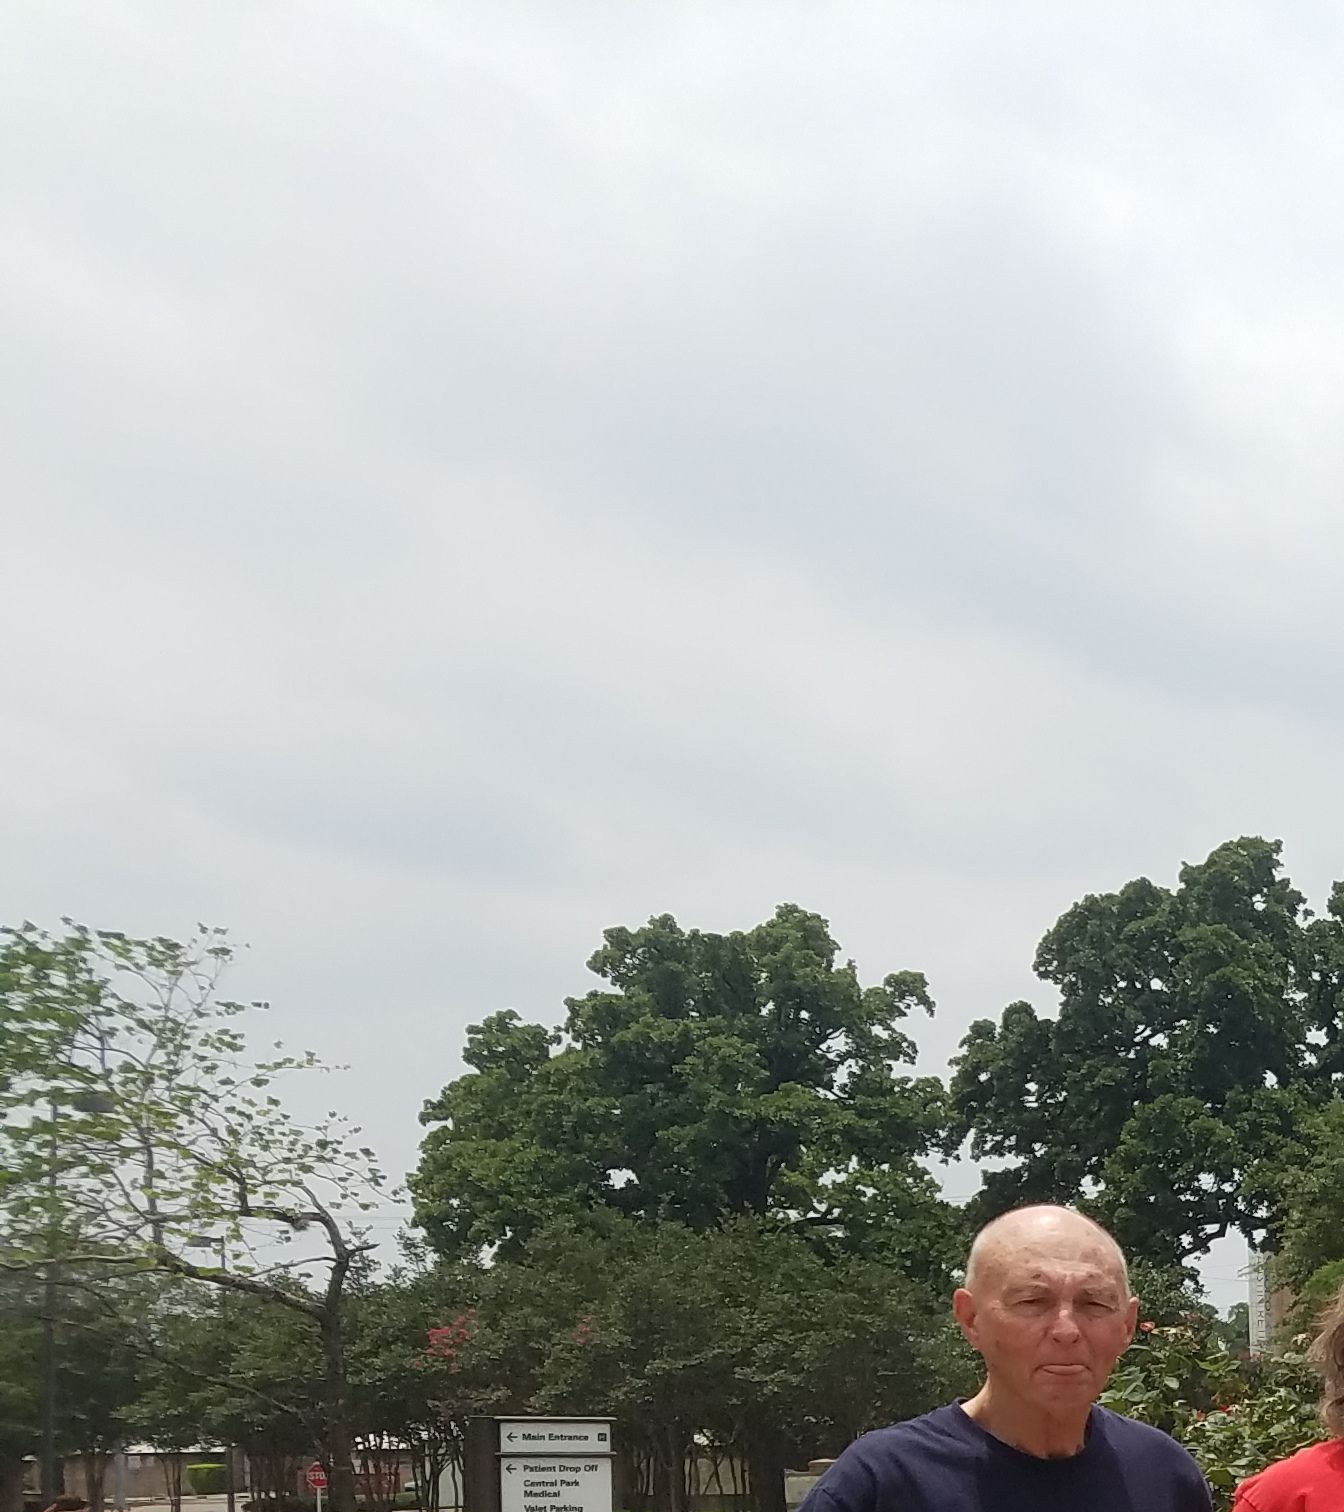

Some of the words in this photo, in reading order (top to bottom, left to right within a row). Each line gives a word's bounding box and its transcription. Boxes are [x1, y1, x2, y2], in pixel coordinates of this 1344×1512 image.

[522, 1433, 545, 1441] Main
[548, 1433, 589, 1441] Entrance
[523, 1464, 556, 1472] Patient
[559, 1465, 581, 1474] Drop
[584, 1464, 598, 1472] Off
[309, 1471, 326, 1480] STO
[524, 1479, 557, 1487] Central
[524, 1490, 560, 1498] Medical
[524, 1504, 547, 1512] Valet
